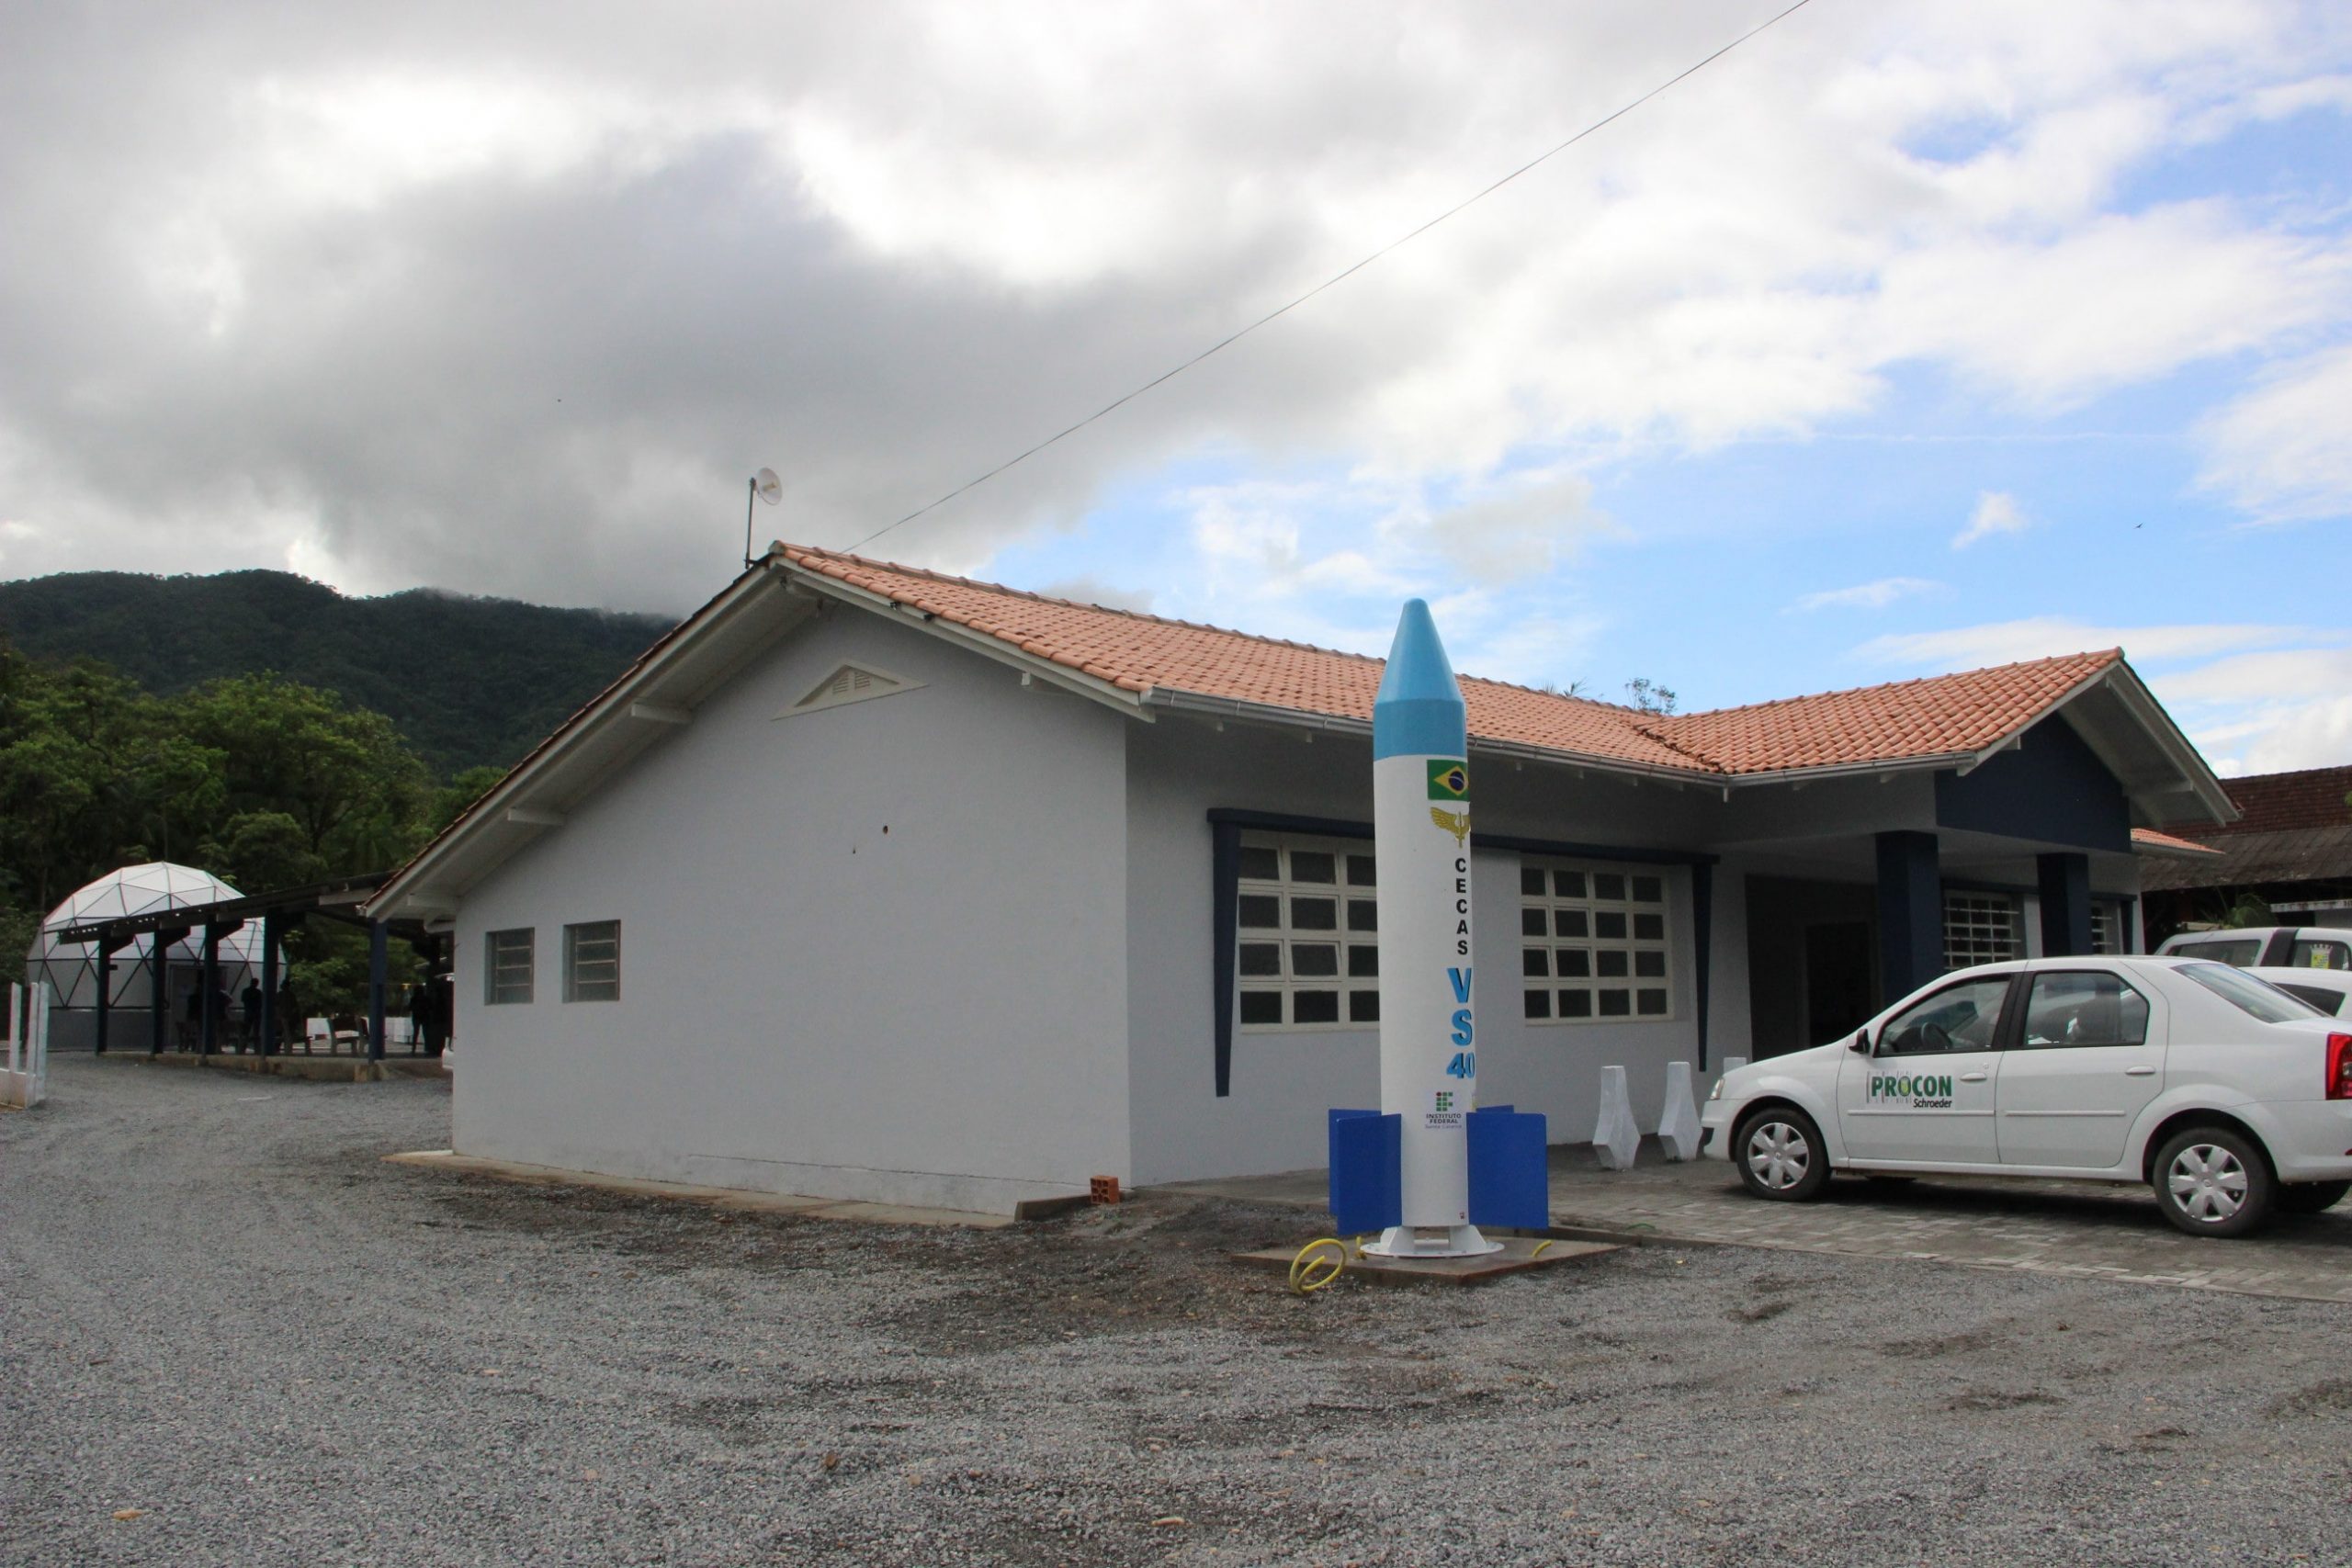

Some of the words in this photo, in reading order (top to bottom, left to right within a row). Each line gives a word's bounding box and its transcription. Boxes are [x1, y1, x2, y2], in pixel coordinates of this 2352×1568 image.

[1455, 858, 1468, 955] CECAS
[1446, 1053, 1476, 1078] 40
[1871, 1076, 1951, 1097] PROCON
[1913, 1098, 1952, 1109] Schroeder
